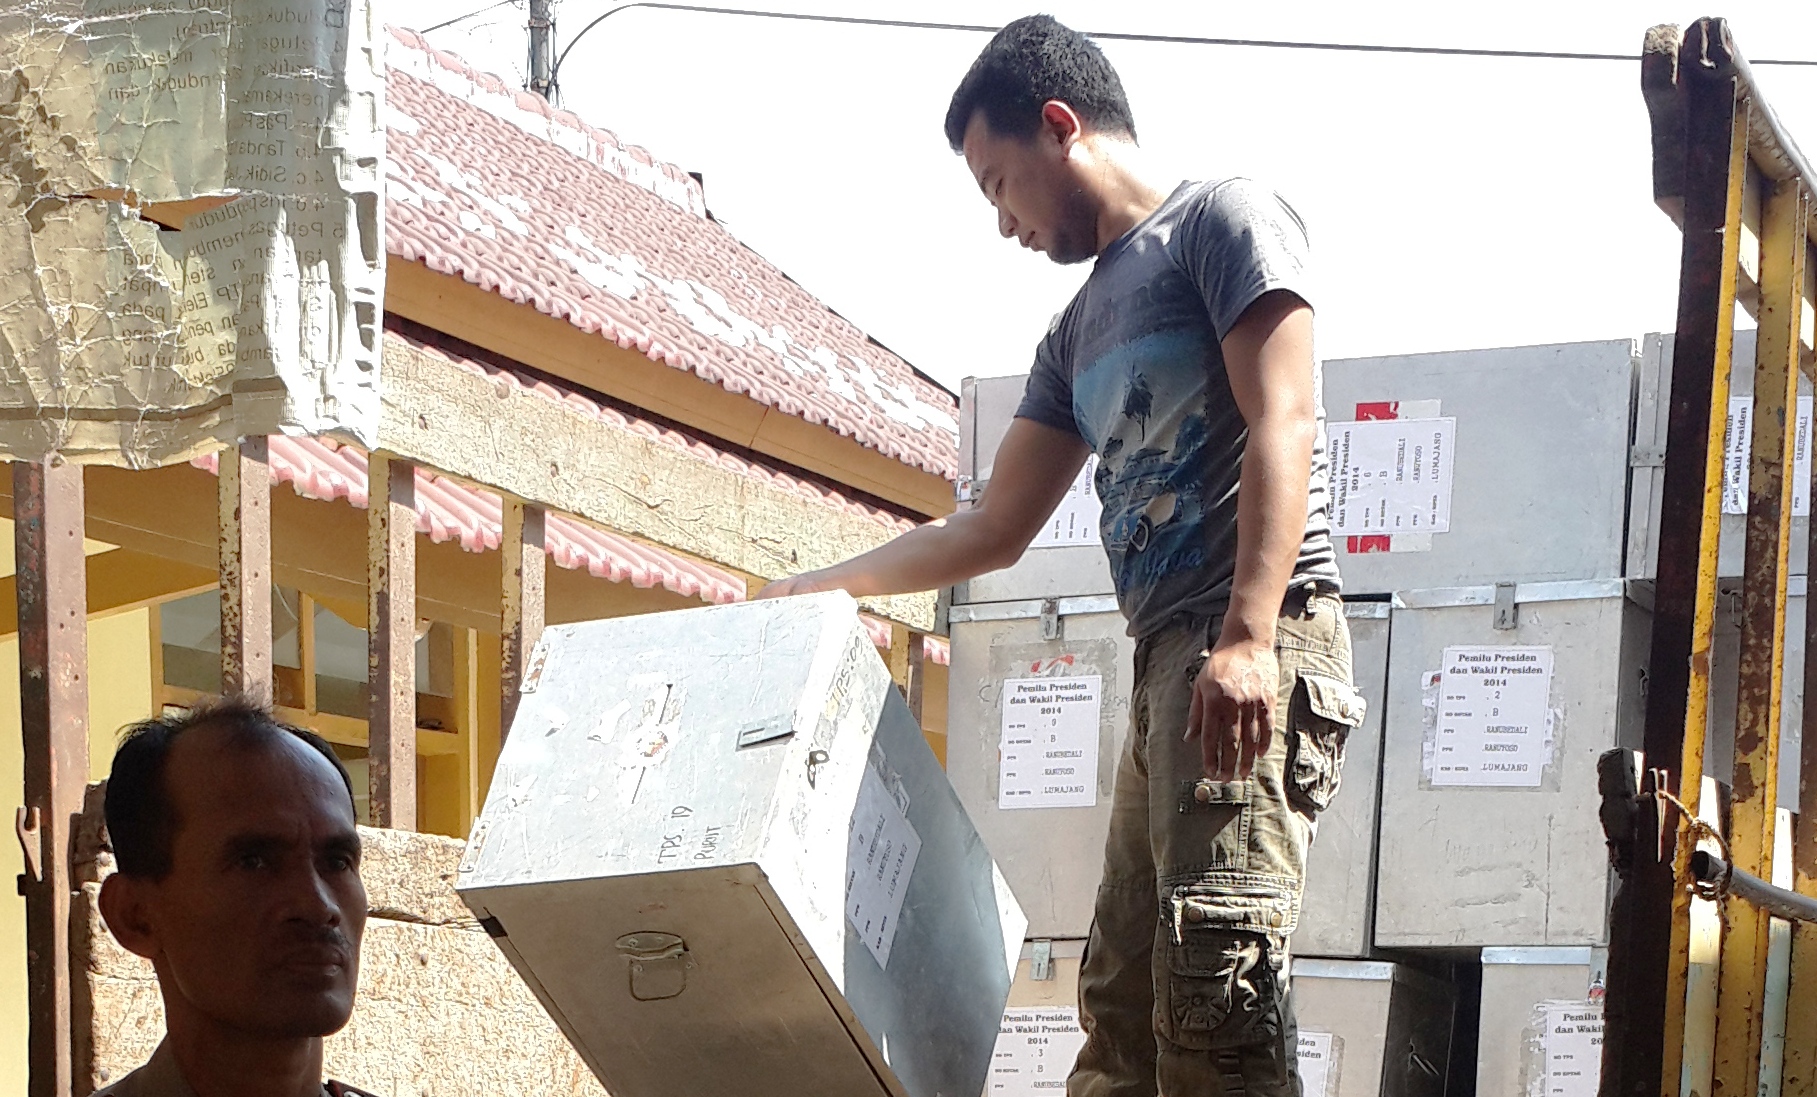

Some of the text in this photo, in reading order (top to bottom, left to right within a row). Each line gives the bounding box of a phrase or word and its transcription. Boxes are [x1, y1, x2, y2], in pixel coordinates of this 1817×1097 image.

[1735, 406, 1747, 453] Presiden
[1329, 439, 1338, 483] Presiden
[1337, 431, 1350, 527] dan Wakil Presiden
[1458, 653, 1537, 662] Pemilu Presiden
[1450, 666, 1543, 674] dan Wakil Presiden
[1017, 683, 1087, 693] Pemilu Presiden
[1028, 695, 1053, 704] Wakil
[1055, 694, 1093, 703] Presiden
[1036, 1014, 1073, 1022] Presiden
[1563, 1013, 1597, 1021] Pemilu
